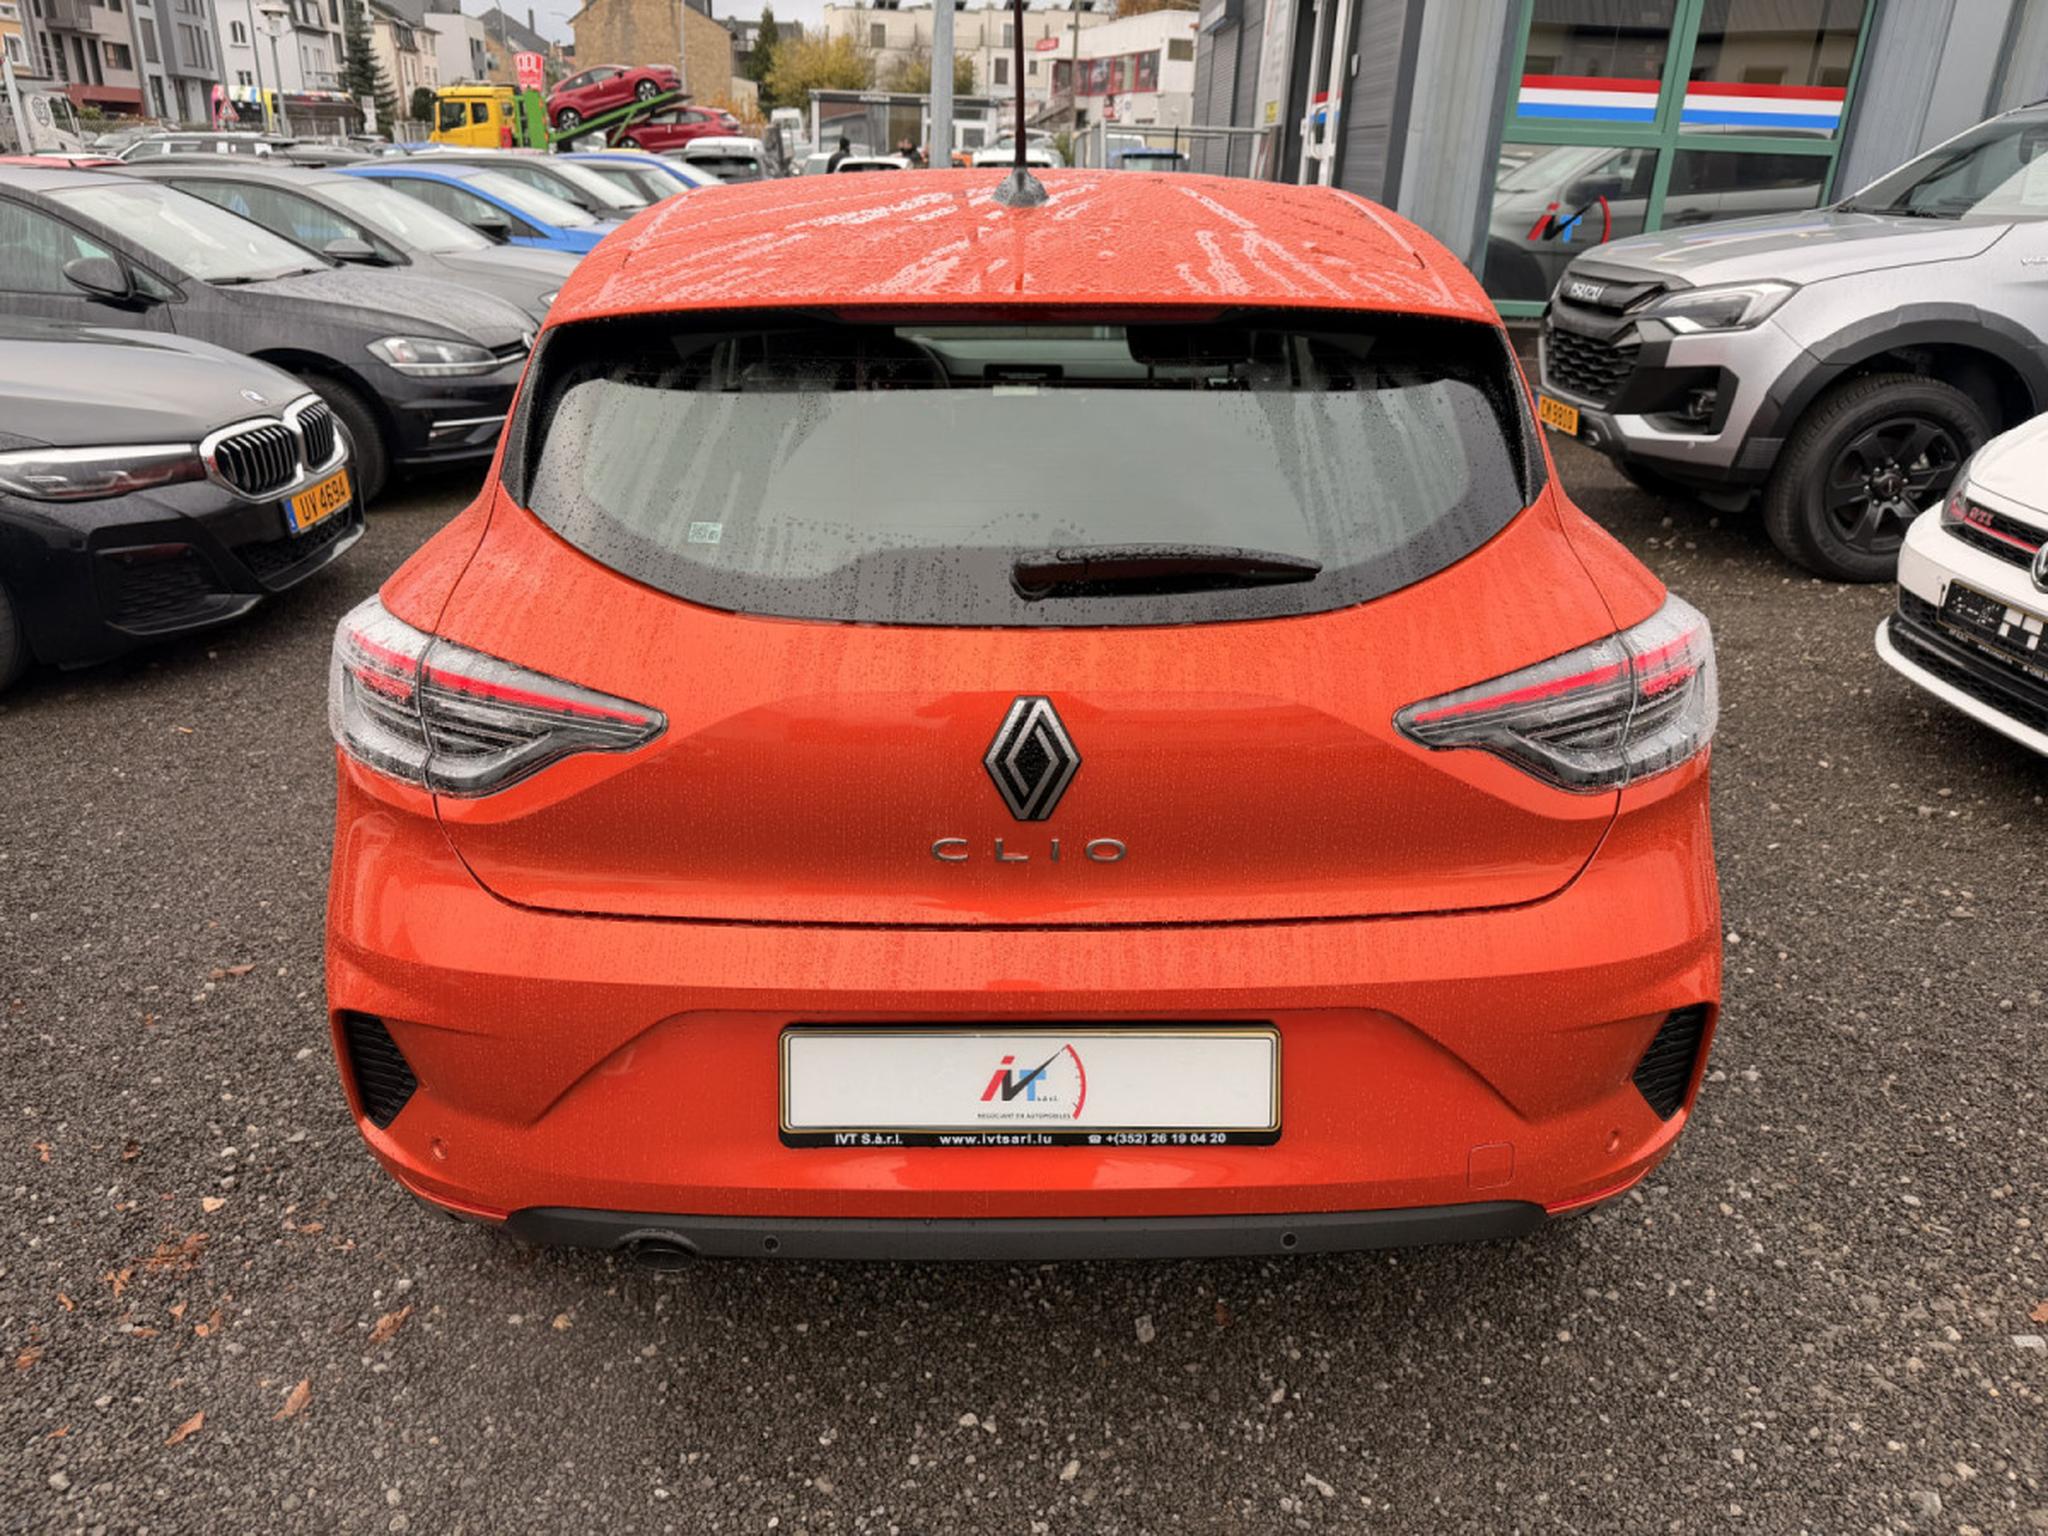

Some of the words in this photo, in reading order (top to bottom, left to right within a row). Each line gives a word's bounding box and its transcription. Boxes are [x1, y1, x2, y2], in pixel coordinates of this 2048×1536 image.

[1569, 282, 1605, 302] ISUZU
[300, 491, 318, 521] UV
[1969, 507, 1993, 527] GTI
[931, 837, 1128, 862] CLIO
[835, 1133, 858, 1145] IVT
[939, 1133, 1052, 1145] www.ivtsarl.lu
[1106, 1133, 1148, 1145] +(352)
[1151, 1133, 1168, 1144] 26
[1171, 1133, 1187, 1144] 19
[1190, 1133, 1207, 1144] 04
[1209, 1133, 1227, 1144] 20
